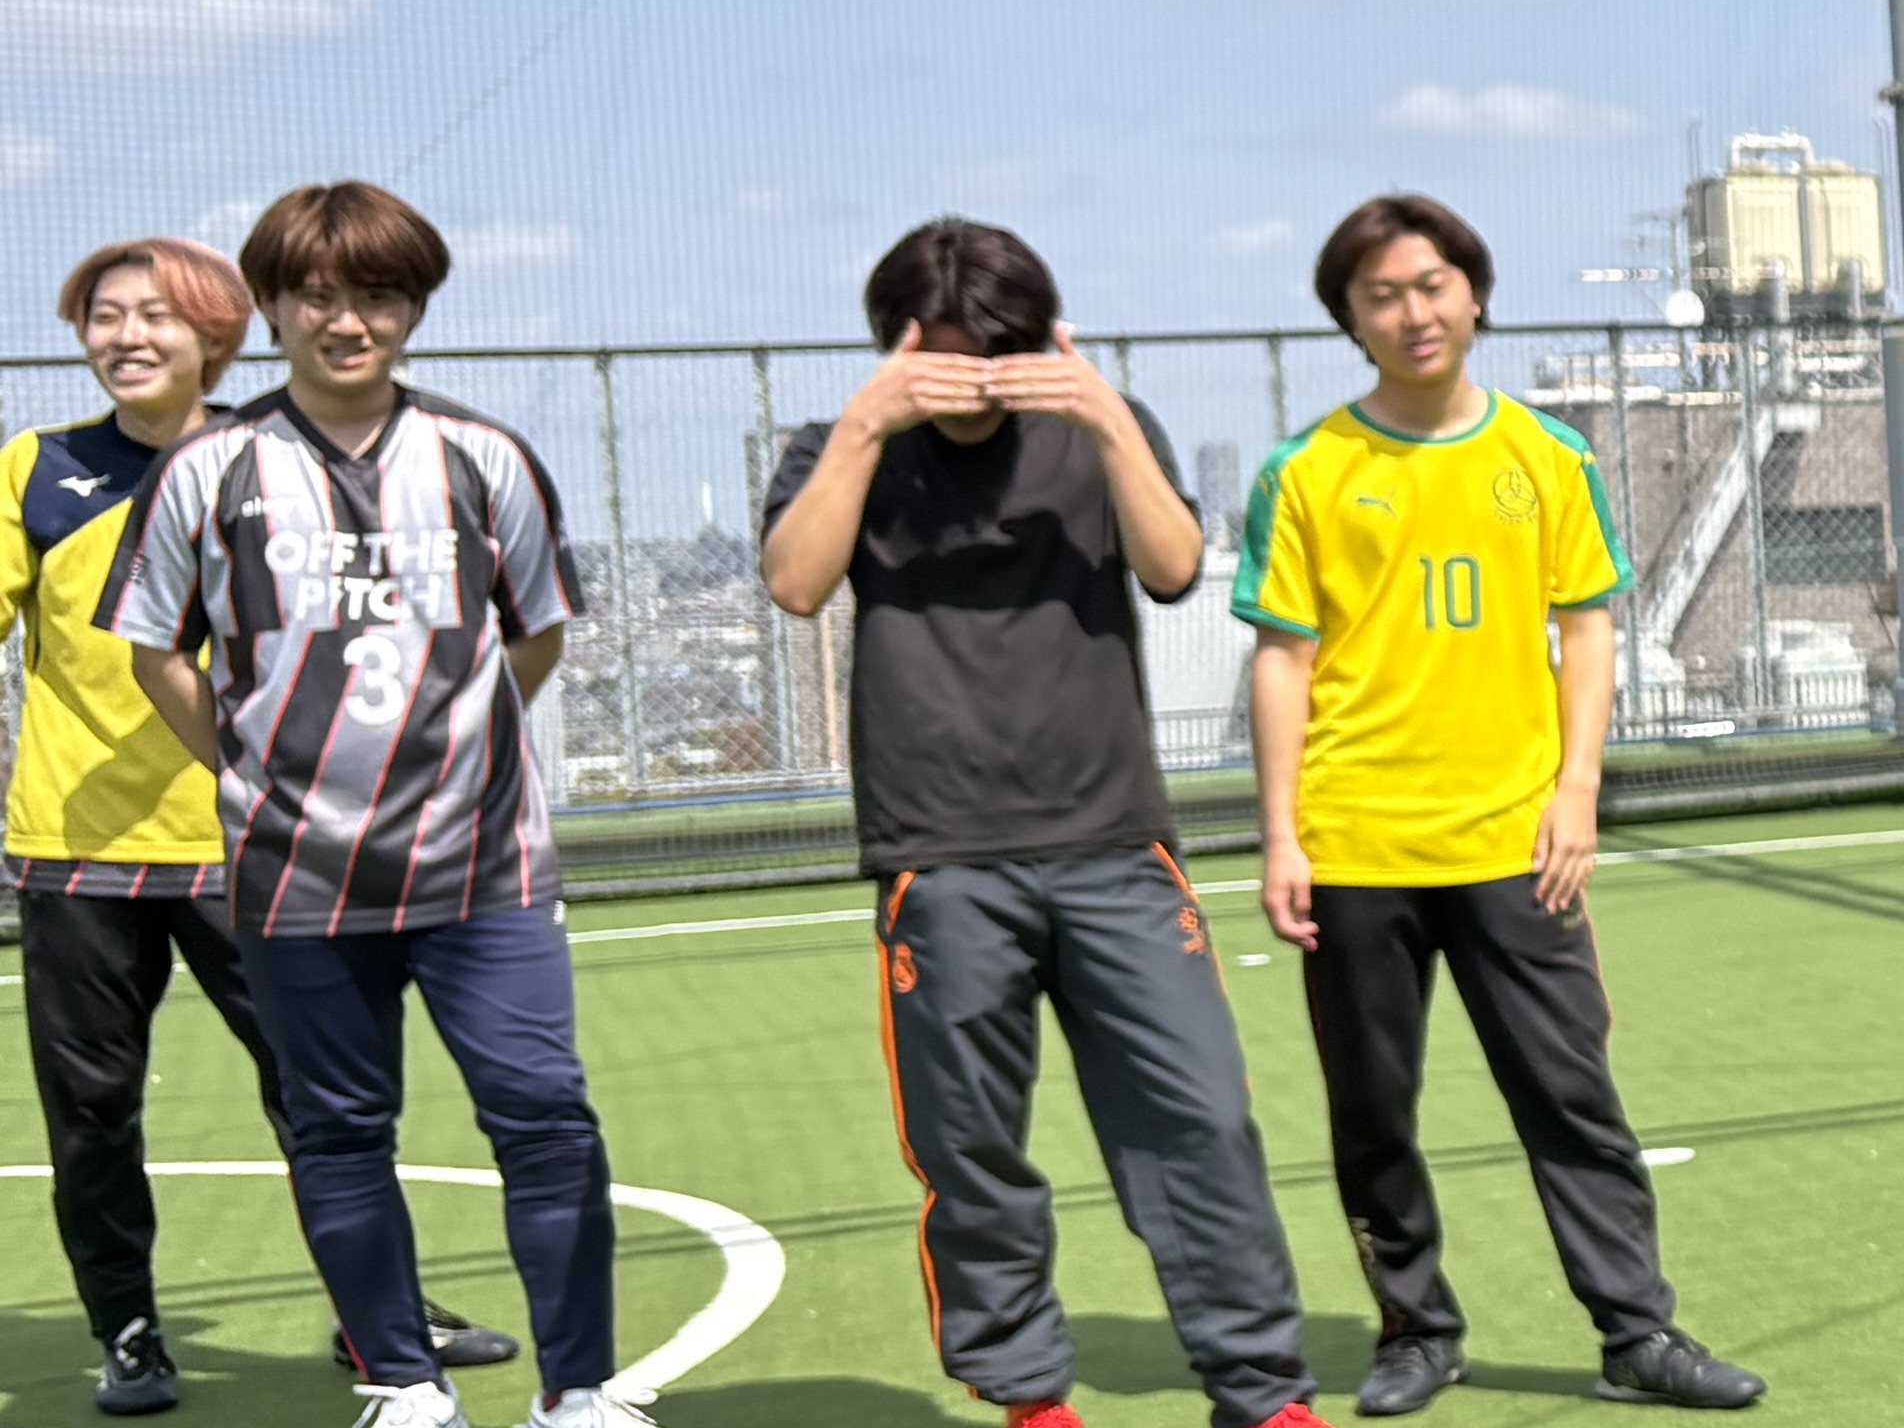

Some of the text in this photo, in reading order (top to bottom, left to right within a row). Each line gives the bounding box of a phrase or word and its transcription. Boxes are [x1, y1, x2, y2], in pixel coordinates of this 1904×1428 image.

[265, 529, 458, 576] OFF THE
[296, 575, 441, 622] PITCH
[1419, 555, 1479, 630] 10
[343, 634, 405, 726] 3
